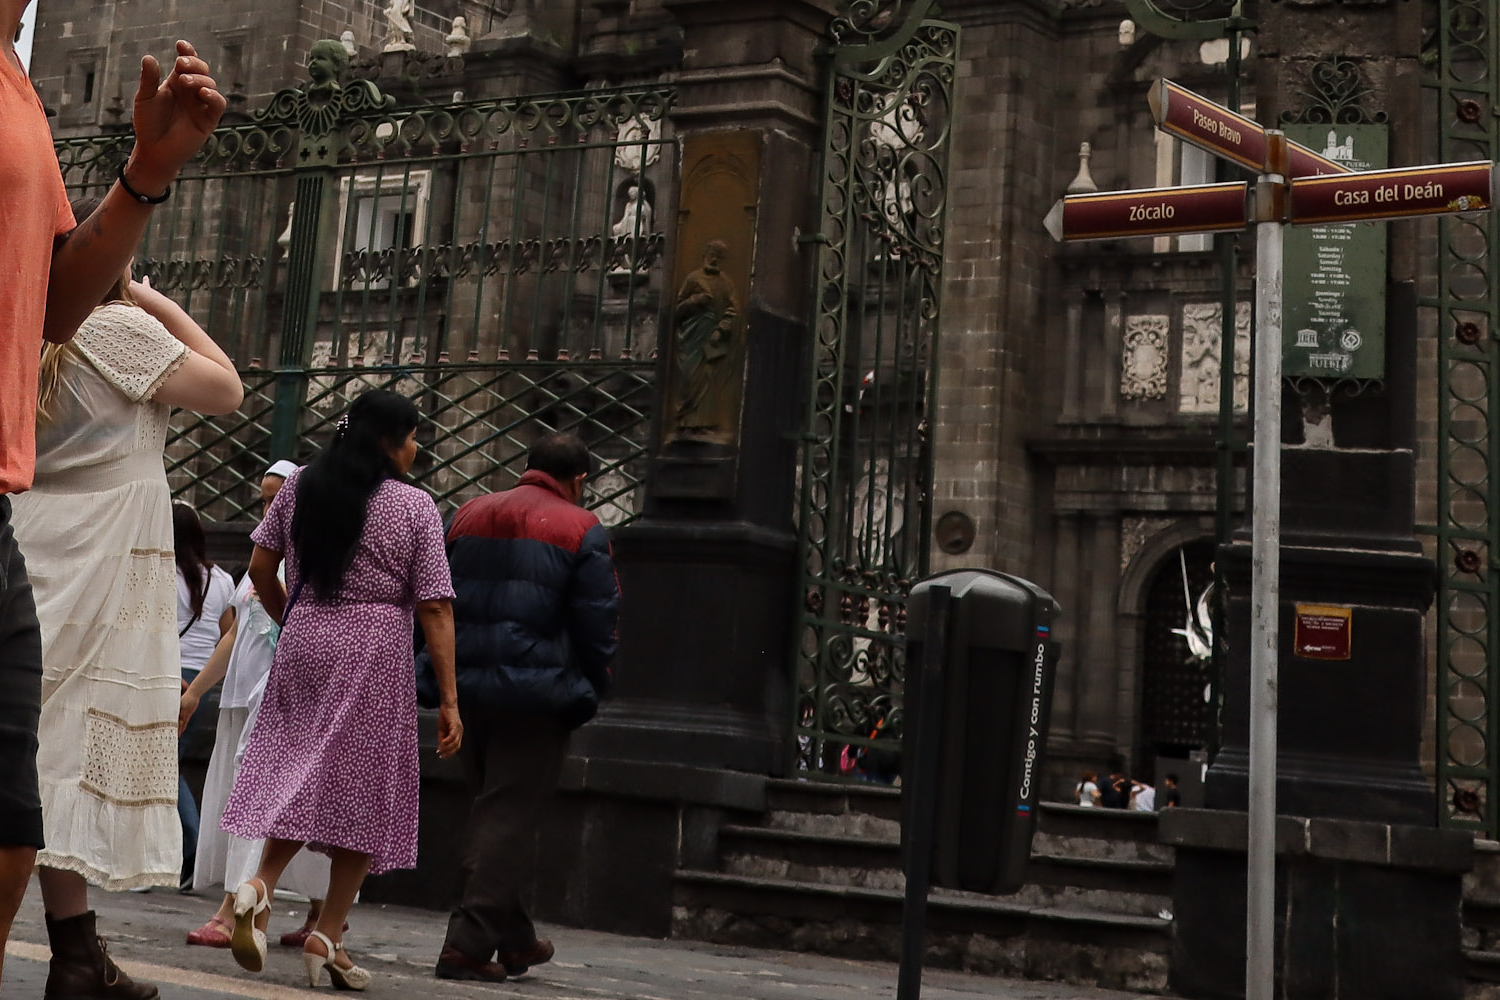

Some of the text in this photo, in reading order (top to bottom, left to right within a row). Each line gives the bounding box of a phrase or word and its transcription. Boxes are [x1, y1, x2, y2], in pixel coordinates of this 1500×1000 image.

[1193, 109, 1242, 145] Paseo Bravo
[1334, 181, 1443, 206] Casa del Deán
[1129, 203, 1175, 221] Zócalo
[1019, 643, 1045, 799] Contigo y con rumbo
